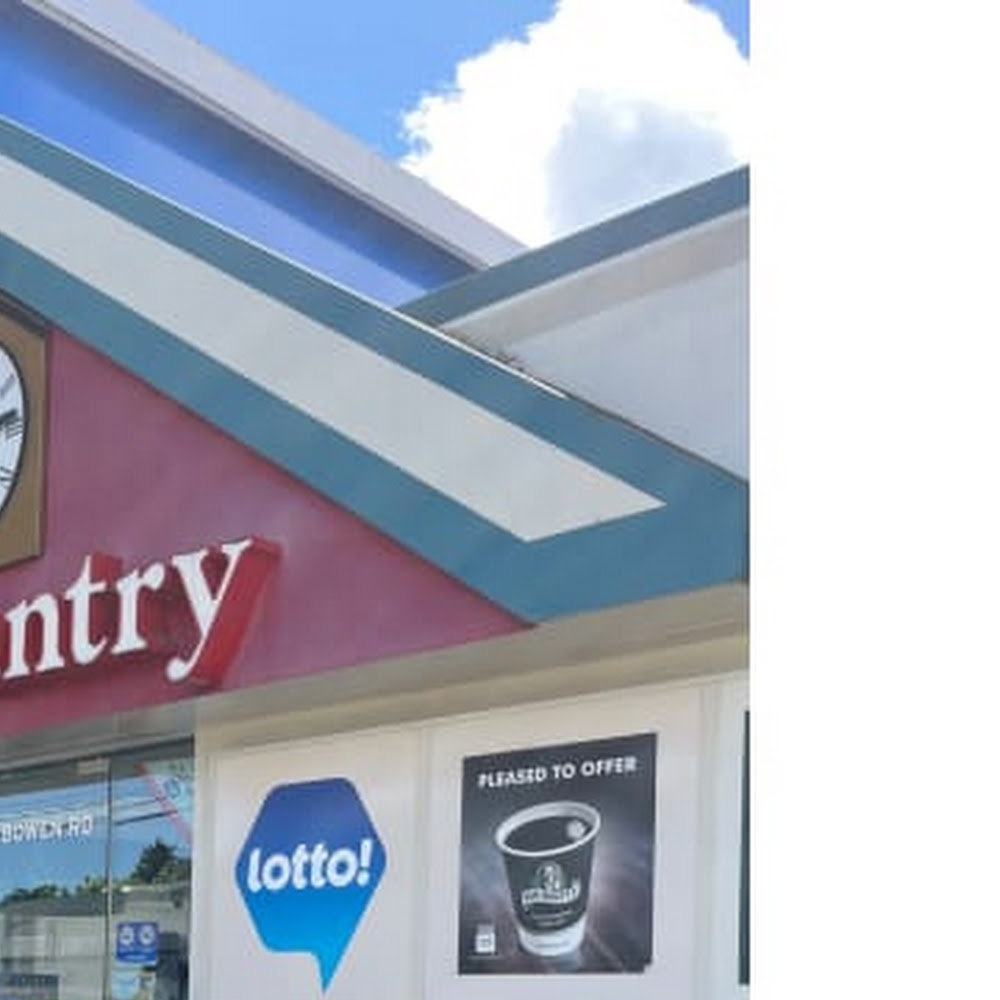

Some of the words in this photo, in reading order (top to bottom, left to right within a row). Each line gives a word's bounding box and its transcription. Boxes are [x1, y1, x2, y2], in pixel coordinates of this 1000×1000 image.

[478, 767, 547, 788] PLEASED
[552, 763, 576, 779] TO
[580, 756, 637, 776] OFFER
[247, 838, 372, 893] lotto!
